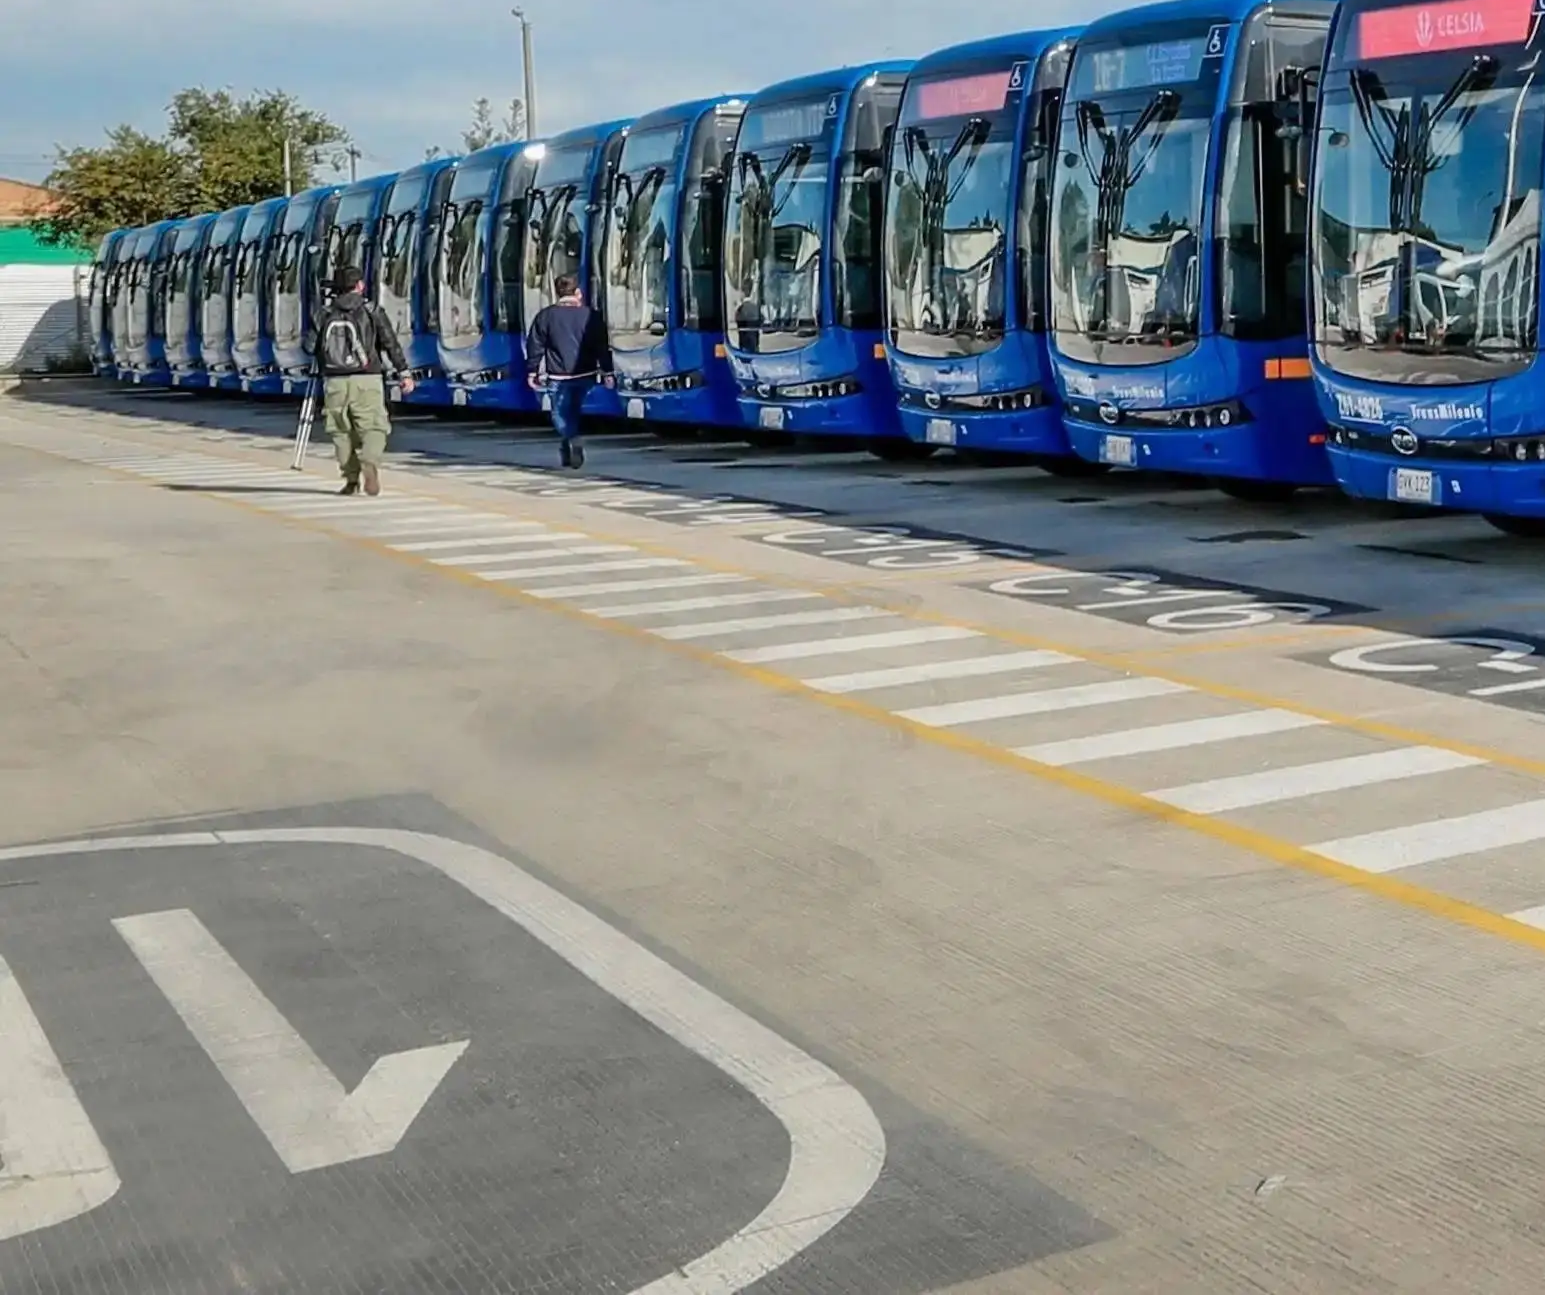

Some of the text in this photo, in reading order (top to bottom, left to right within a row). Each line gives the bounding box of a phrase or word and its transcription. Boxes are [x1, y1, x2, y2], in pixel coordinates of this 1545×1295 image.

[1438, 11, 1485, 38] CELSIA
[762, 525, 1036, 570] C-15
[988, 571, 1333, 632] C-16
